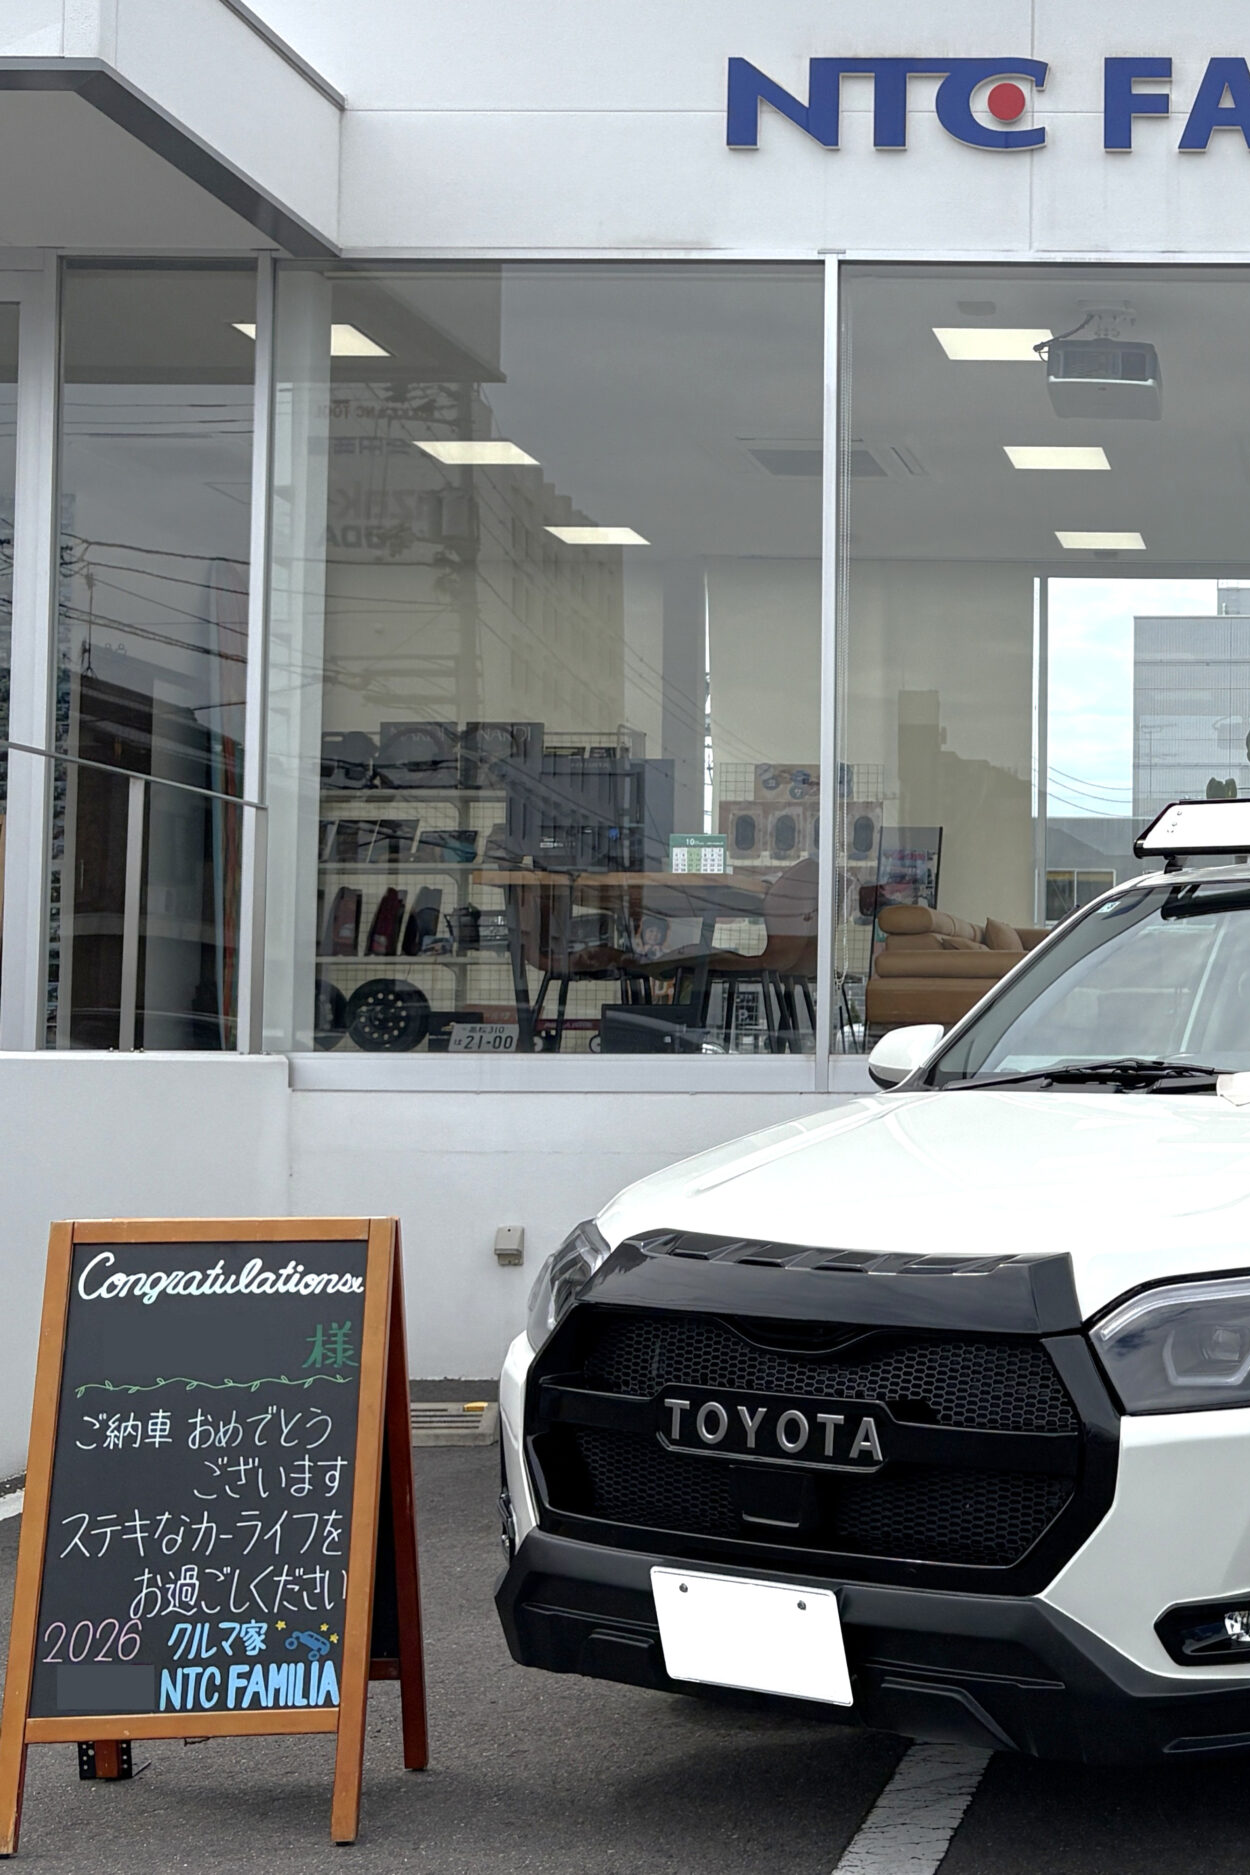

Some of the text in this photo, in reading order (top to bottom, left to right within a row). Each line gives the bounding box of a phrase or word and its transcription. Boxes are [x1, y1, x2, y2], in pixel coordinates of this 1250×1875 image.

[728, 58, 1048, 150] NTC
[464, 1035, 514, 1049] 21-00
[302, 1320, 358, 1368] 様
[76, 1405, 332, 1450] ご納車 おめでとう
[664, 1399, 883, 1462] TOYOTA
[193, 1454, 348, 1499] ございます
[60, 1509, 344, 1558] ステキなカーライフを
[129, 1564, 348, 1619] お過ごしください
[42, 1619, 143, 1663] 2026
[167, 1619, 269, 1660] クルマ家
[159, 1660, 340, 1711] NTC FAMILIA
